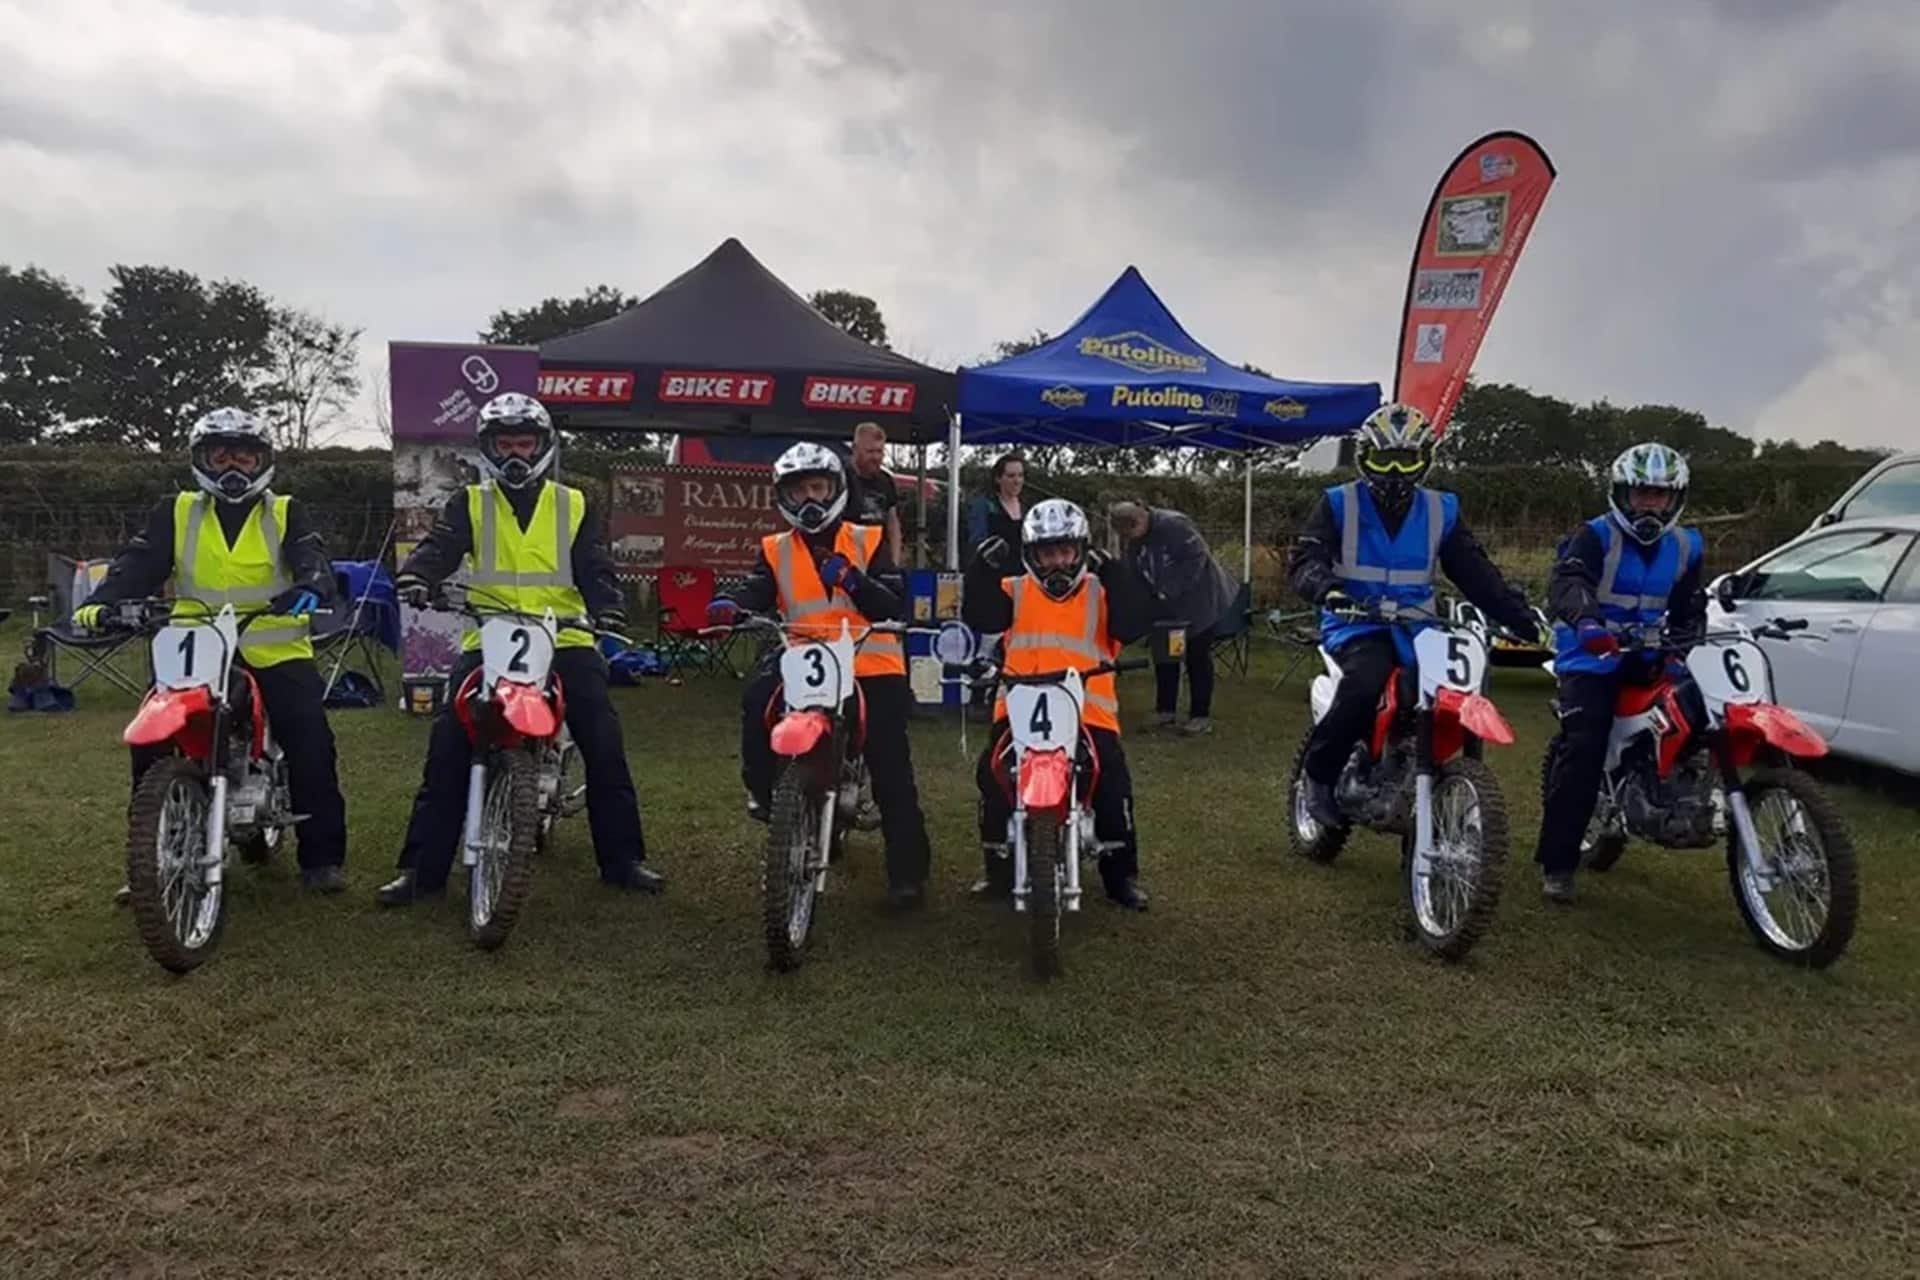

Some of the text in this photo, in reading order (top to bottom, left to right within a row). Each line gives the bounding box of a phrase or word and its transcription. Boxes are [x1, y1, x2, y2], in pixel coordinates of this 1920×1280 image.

[1080, 337, 1207, 369] Putoline
[598, 377, 629, 397] IT
[665, 377, 769, 400] BIKE IT
[808, 383, 910, 407] BIKE IT
[1112, 385, 1204, 408] Putoline
[178, 630, 195, 677] 1
[508, 628, 531, 674] 2
[804, 648, 826, 687] 3
[1446, 637, 1471, 687] 5
[1722, 648, 1750, 692] 6
[1029, 692, 1053, 740] 4
